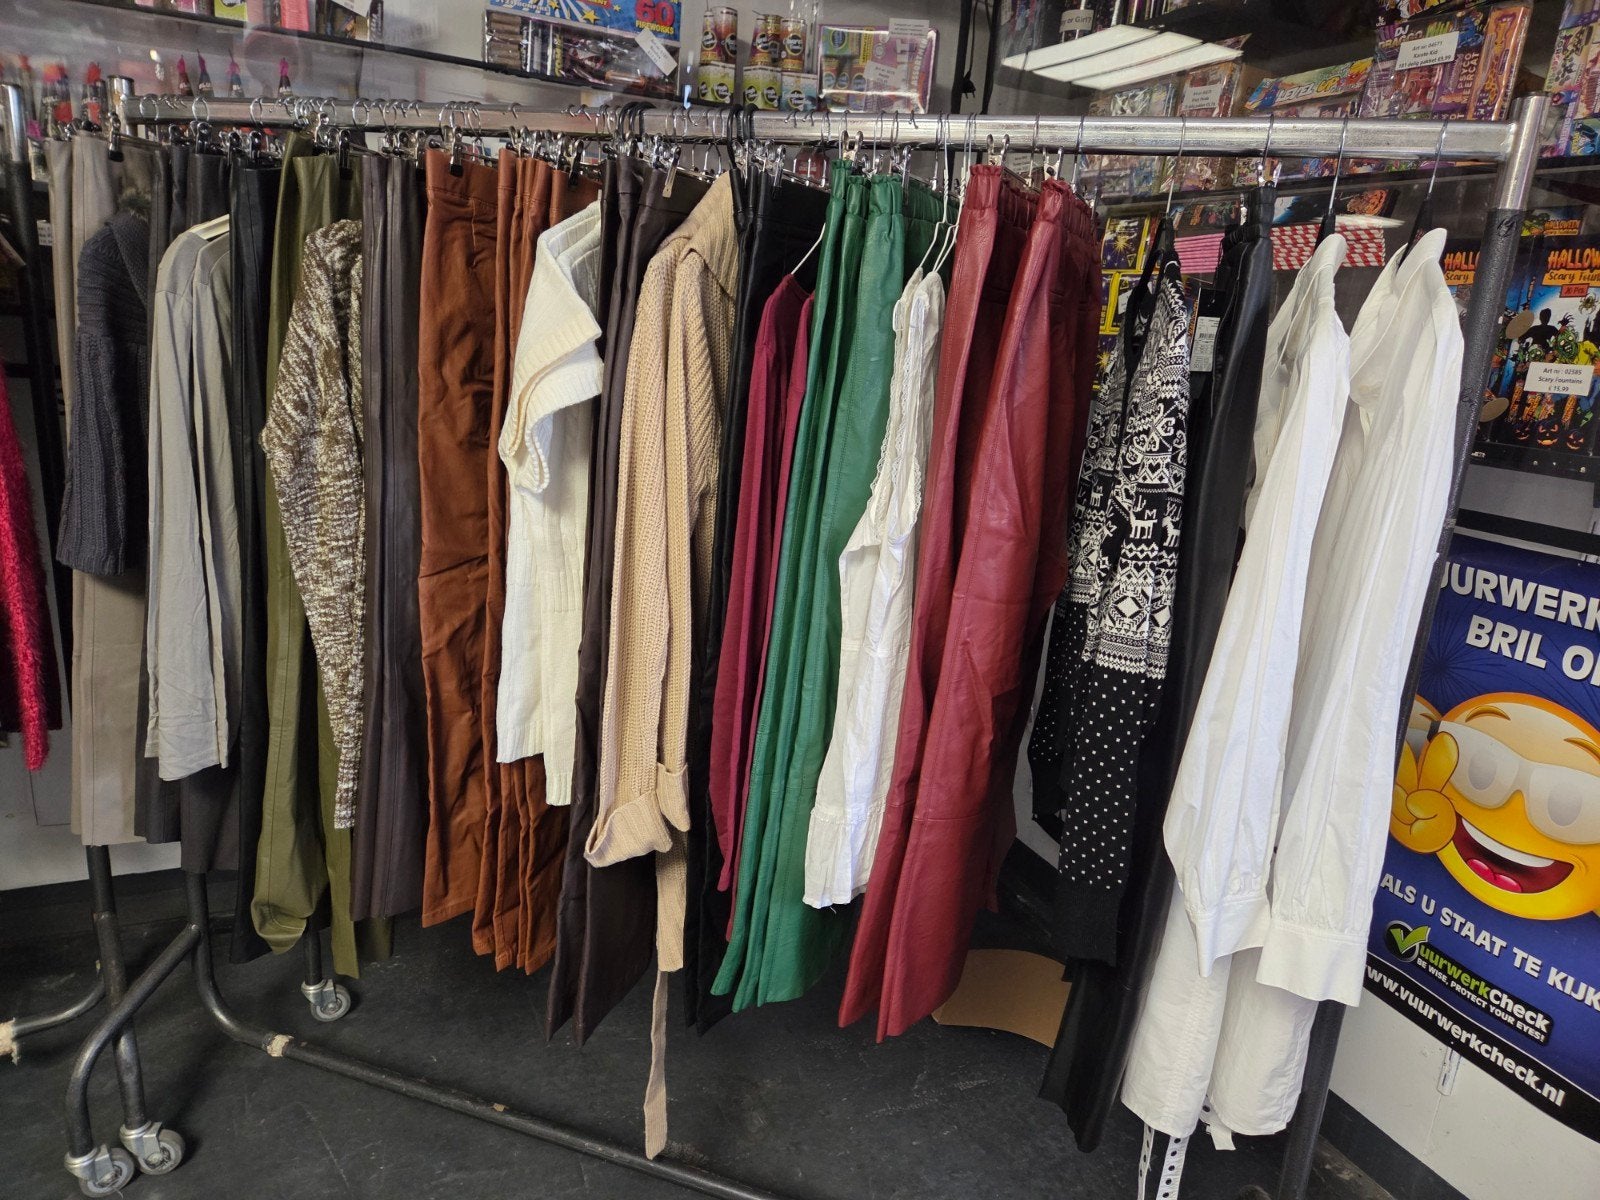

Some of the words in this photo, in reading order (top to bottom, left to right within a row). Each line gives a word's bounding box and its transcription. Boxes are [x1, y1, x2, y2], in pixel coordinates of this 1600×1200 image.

[634, 0, 675, 28] 60
[635, 19, 675, 35] FIREWORKS
[1394, 24, 1410, 38] DJ
[1457, 52, 1473, 90] PSYCO
[1460, 52, 1480, 105] MEERCAT
[1276, 82, 1316, 101] LEVEL
[1445, 272, 1470, 284] Scary
[1548, 271, 1576, 284] Scary
[1537, 375, 1554, 384] Scary
[1555, 376, 1584, 385] Fountains
[1542, 367, 1553, 375] Art
[1465, 614, 1547, 669] BRIL
[1380, 873, 1417, 904] ALS
[1421, 894, 1436, 915] U
[1440, 907, 1508, 957] STAAT
[1512, 946, 1543, 978] TE
[1416, 957, 1428, 969] BE
[1428, 965, 1449, 985] WISE,
[1450, 980, 1488, 1009] PROTECT
[1489, 1004, 1516, 1026] YOUR
[1516, 1020, 1546, 1043] EYES!
[1366, 965, 1566, 1107] ww.vuurwerkcheck.nl
